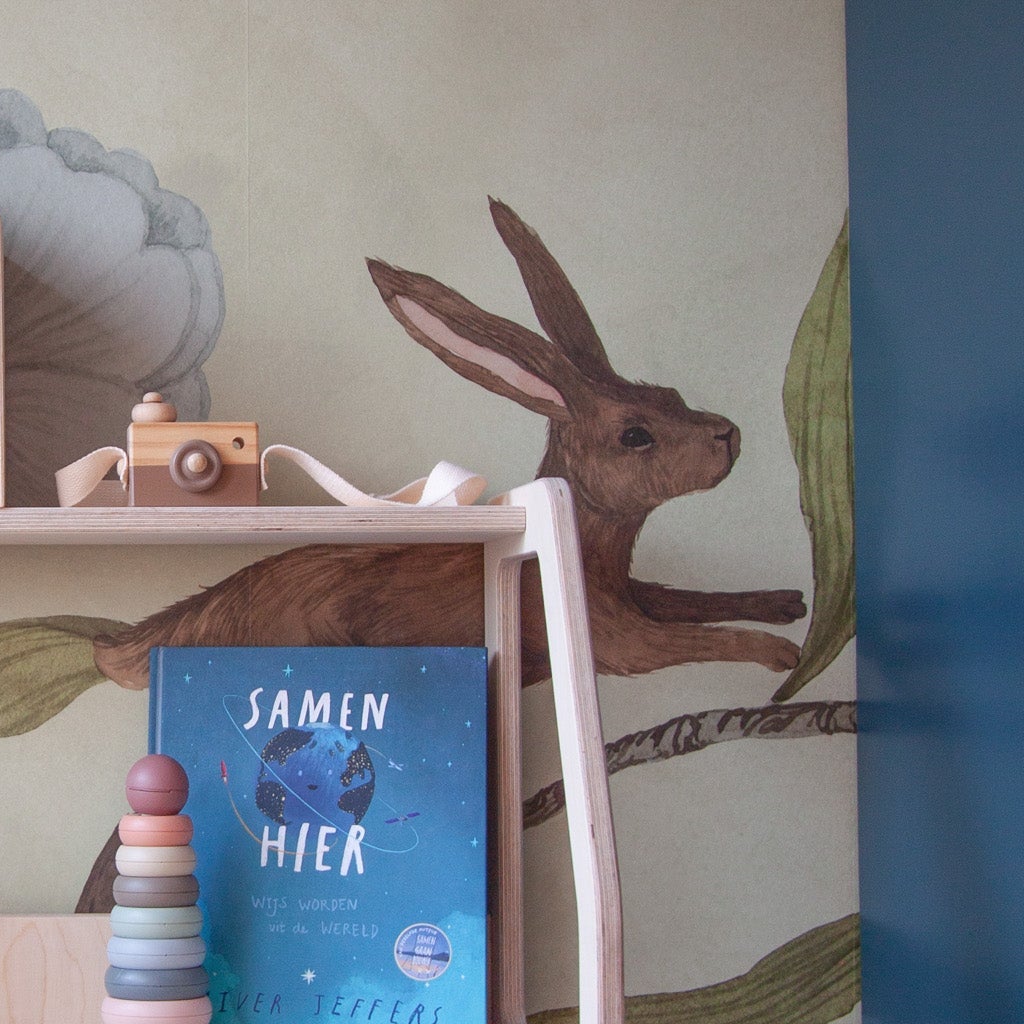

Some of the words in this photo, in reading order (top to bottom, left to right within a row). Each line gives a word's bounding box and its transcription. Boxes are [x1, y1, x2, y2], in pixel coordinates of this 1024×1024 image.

[243, 687, 389, 731] SAMEN
[260, 822, 366, 876] HIER
[251, 896, 288, 917] WIJS
[298, 899, 358, 912] WORDEN
[269, 920, 286, 933] uit
[292, 921, 309, 934] de
[321, 921, 379, 939] WERELD
[206, 990, 282, 1015] IVER
